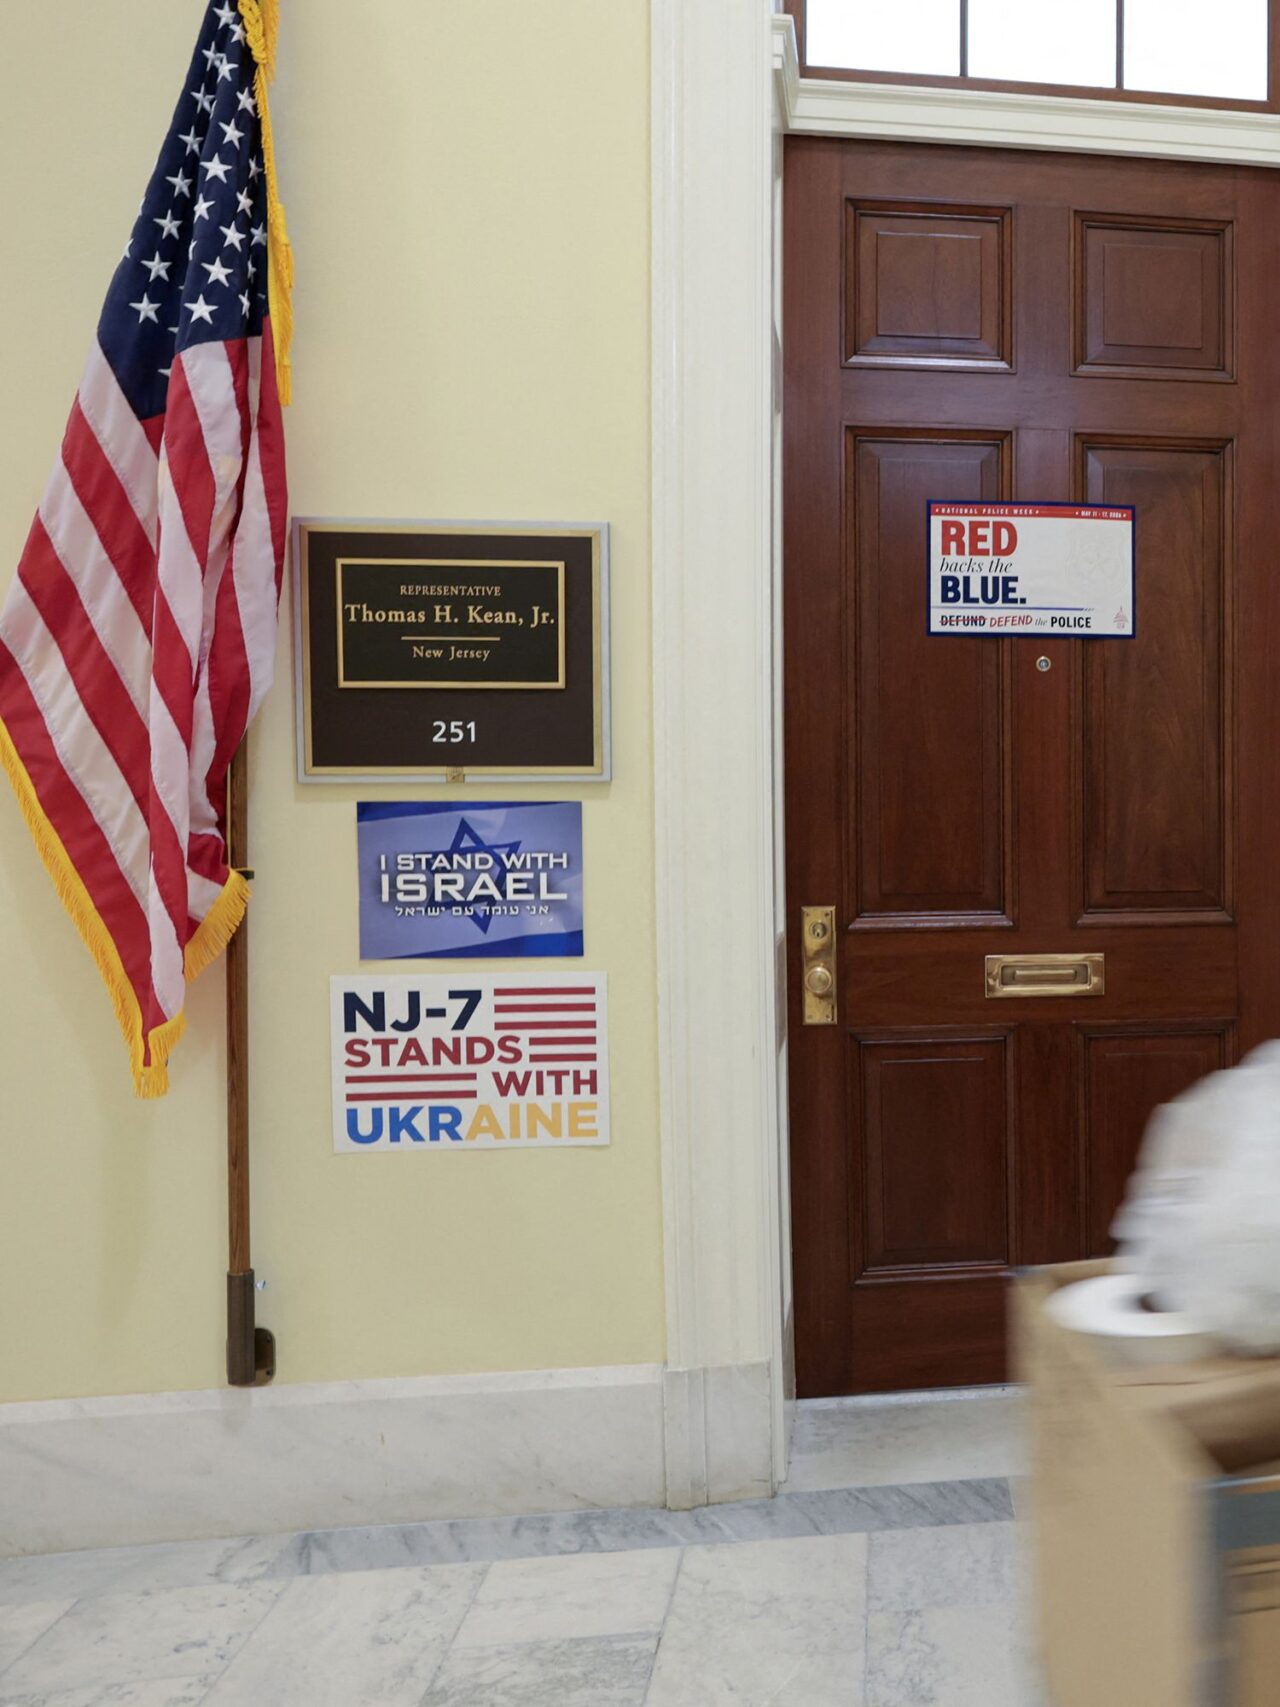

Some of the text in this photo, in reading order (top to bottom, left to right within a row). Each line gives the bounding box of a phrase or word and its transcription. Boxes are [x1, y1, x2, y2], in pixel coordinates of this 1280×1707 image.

[941, 520, 1017, 556] RED
[940, 558, 1013, 573] backs the
[400, 585, 501, 596] REPRESENTATIVE
[941, 576, 1026, 604] BLUE.
[345, 604, 555, 628] Thomas H. Kean, Jr.
[940, 615, 987, 626] DEFUND
[990, 615, 1033, 627] DEFEND
[1051, 617, 1092, 628] POLICE
[413, 645, 491, 661] New Jersey
[432, 721, 476, 743] 251
[380, 853, 568, 870] I STAND WITH
[381, 872, 567, 902] ISRAEL
[395, 904, 549, 917] אני עומד עם ישראל
[343, 990, 482, 1032] NJ-7
[344, 1035, 522, 1068] STANDS
[492, 1069, 597, 1096] WITH
[346, 1102, 598, 1144] UKRAINE
